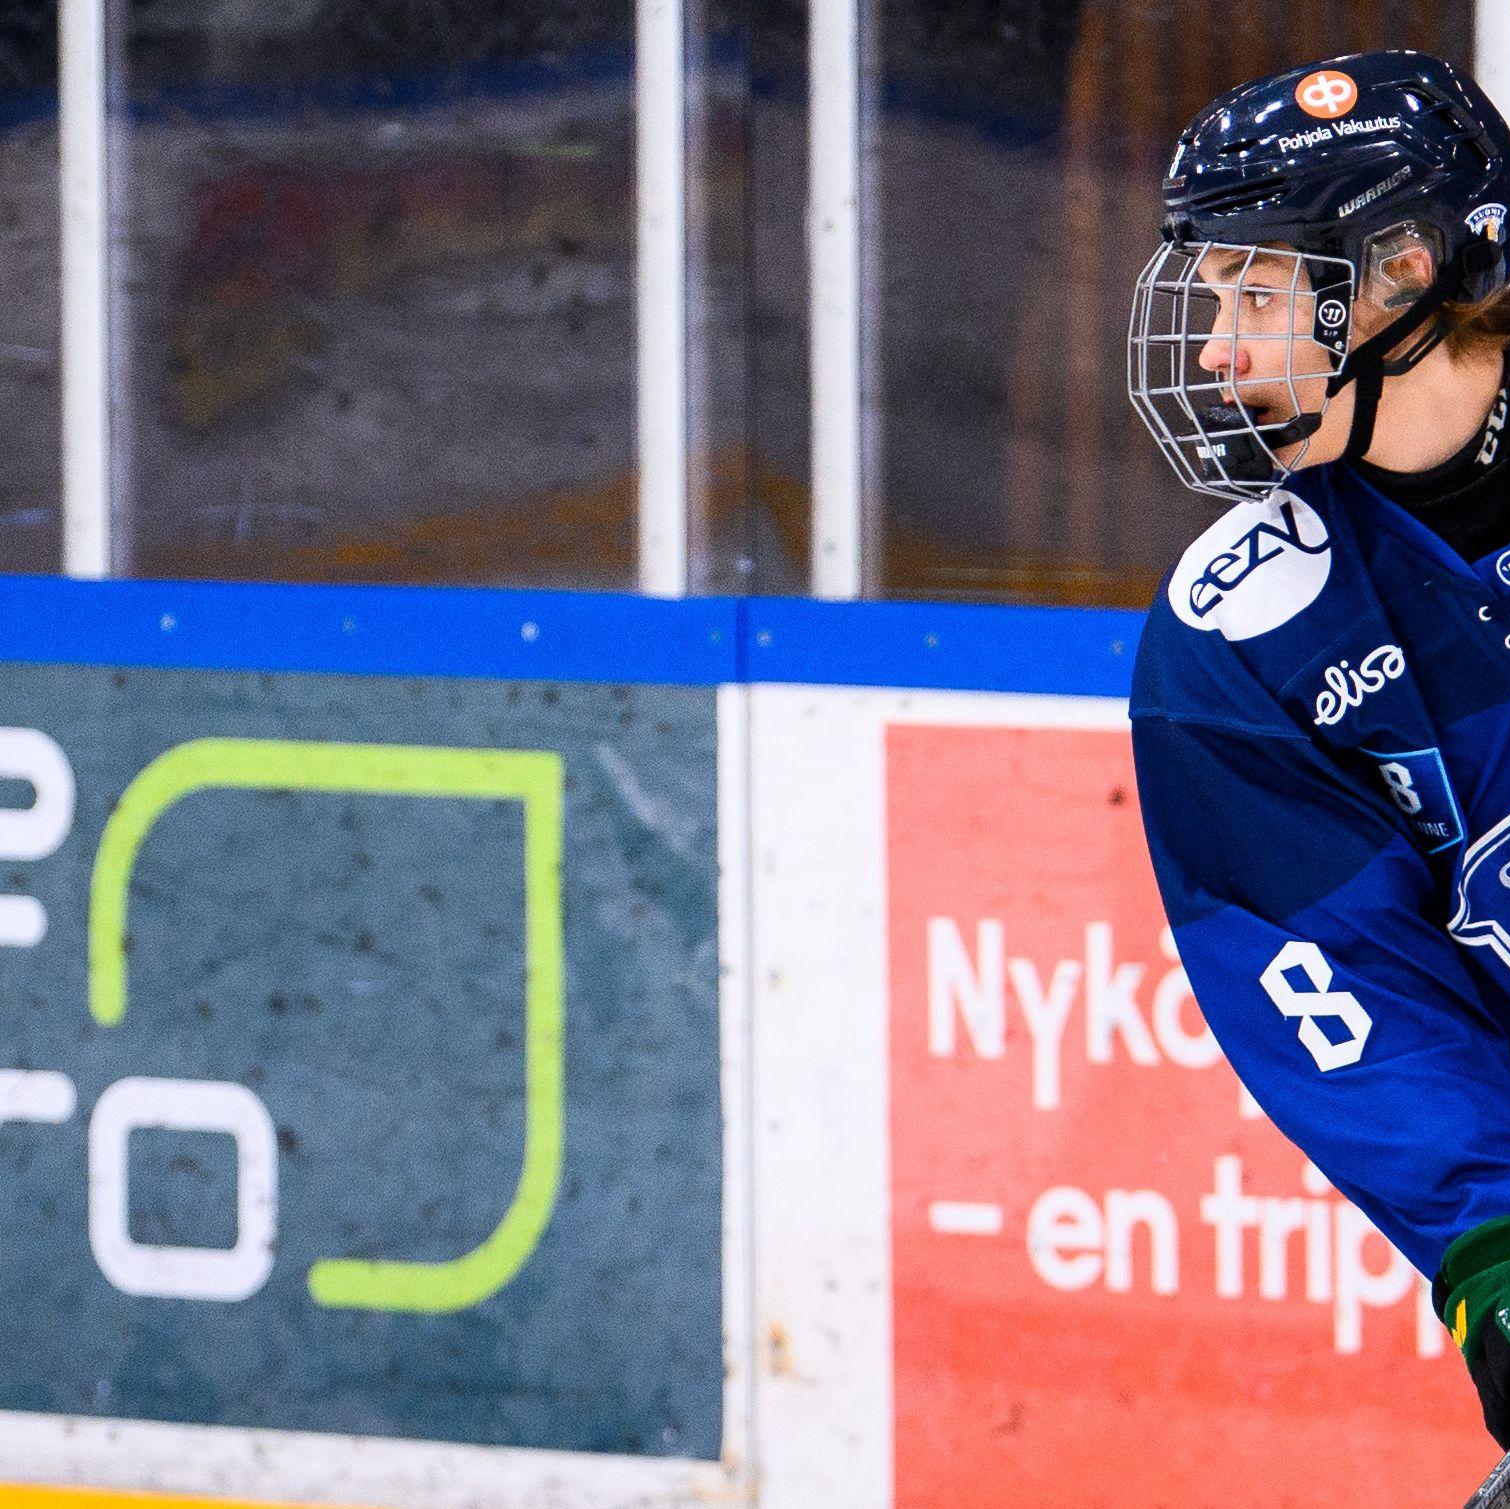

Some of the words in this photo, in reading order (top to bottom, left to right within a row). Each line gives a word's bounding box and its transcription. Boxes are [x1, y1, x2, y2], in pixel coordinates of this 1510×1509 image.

[1278, 126, 1333, 153] Pohjola
[1331, 115, 1401, 137] Vakuutus
[1190, 501, 1331, 619] eezy
[1313, 645, 1405, 726] elisa
[1379, 762, 1422, 816] 8
[1259, 940, 1373, 1072] 8
[1026, 1185, 1180, 1296] en
